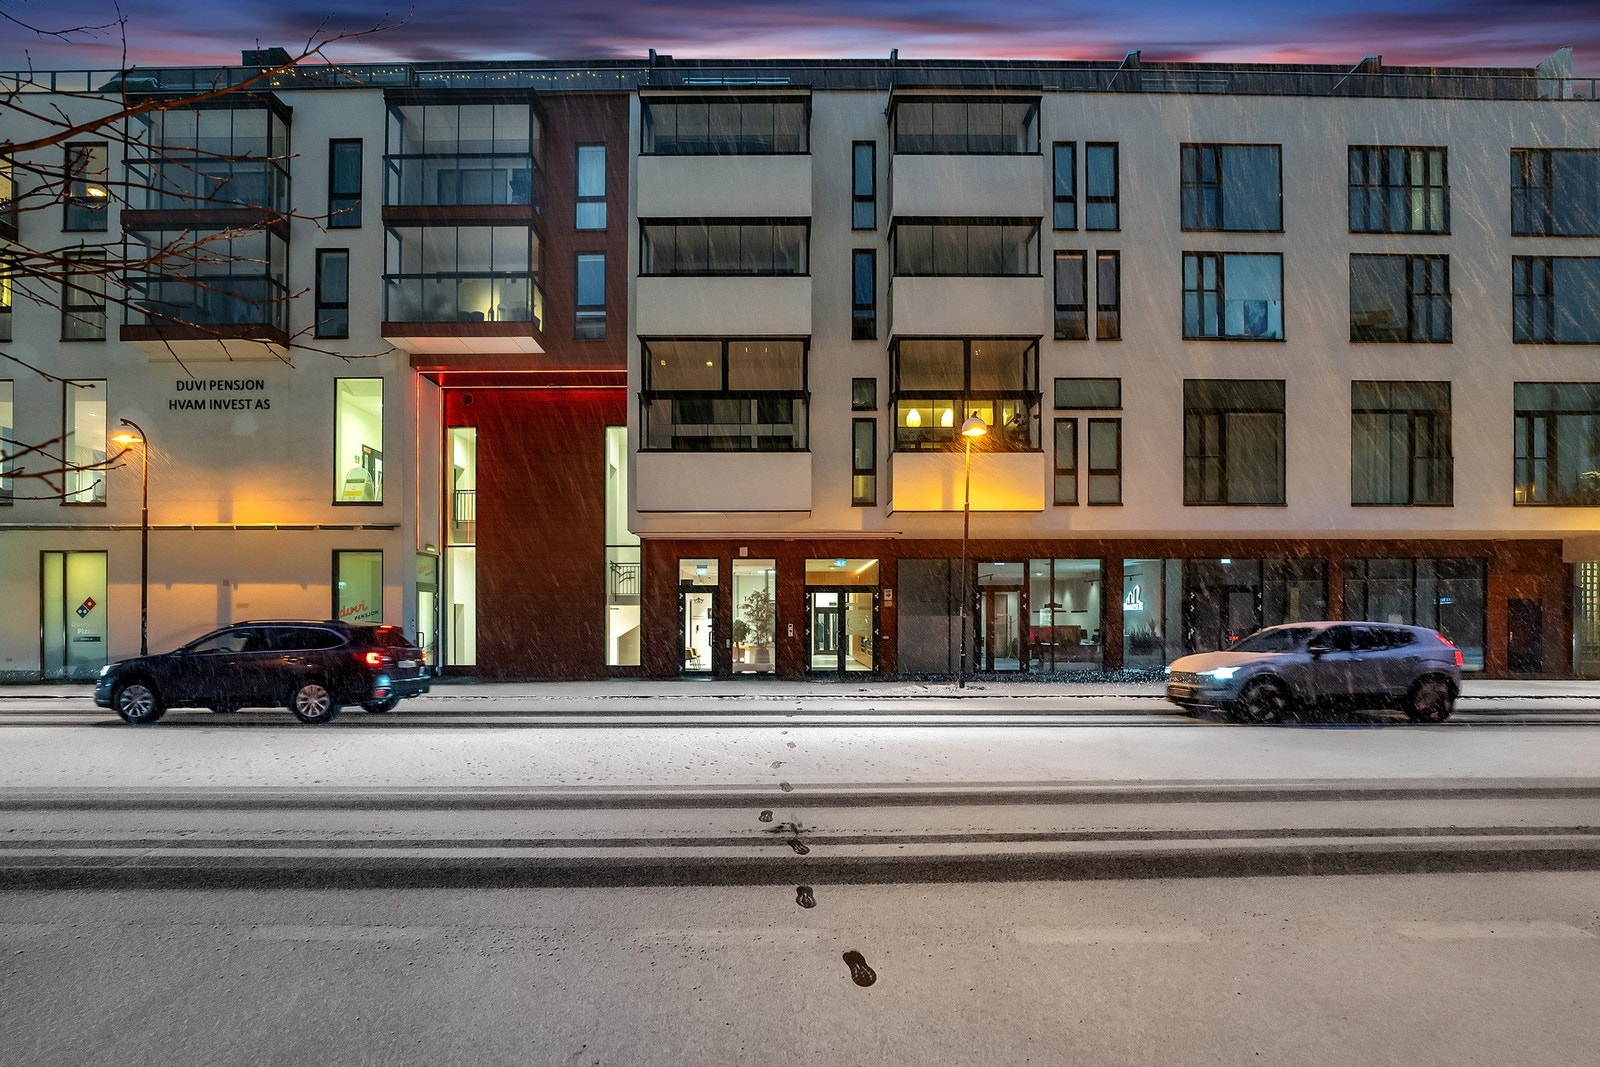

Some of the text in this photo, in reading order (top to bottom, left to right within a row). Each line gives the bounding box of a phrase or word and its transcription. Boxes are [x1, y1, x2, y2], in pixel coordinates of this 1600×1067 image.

[176, 380, 264, 391] DUVI PENSJON
[169, 399, 271, 410] HVAM INVEST AS
[354, 610, 379, 620] PENSJON
